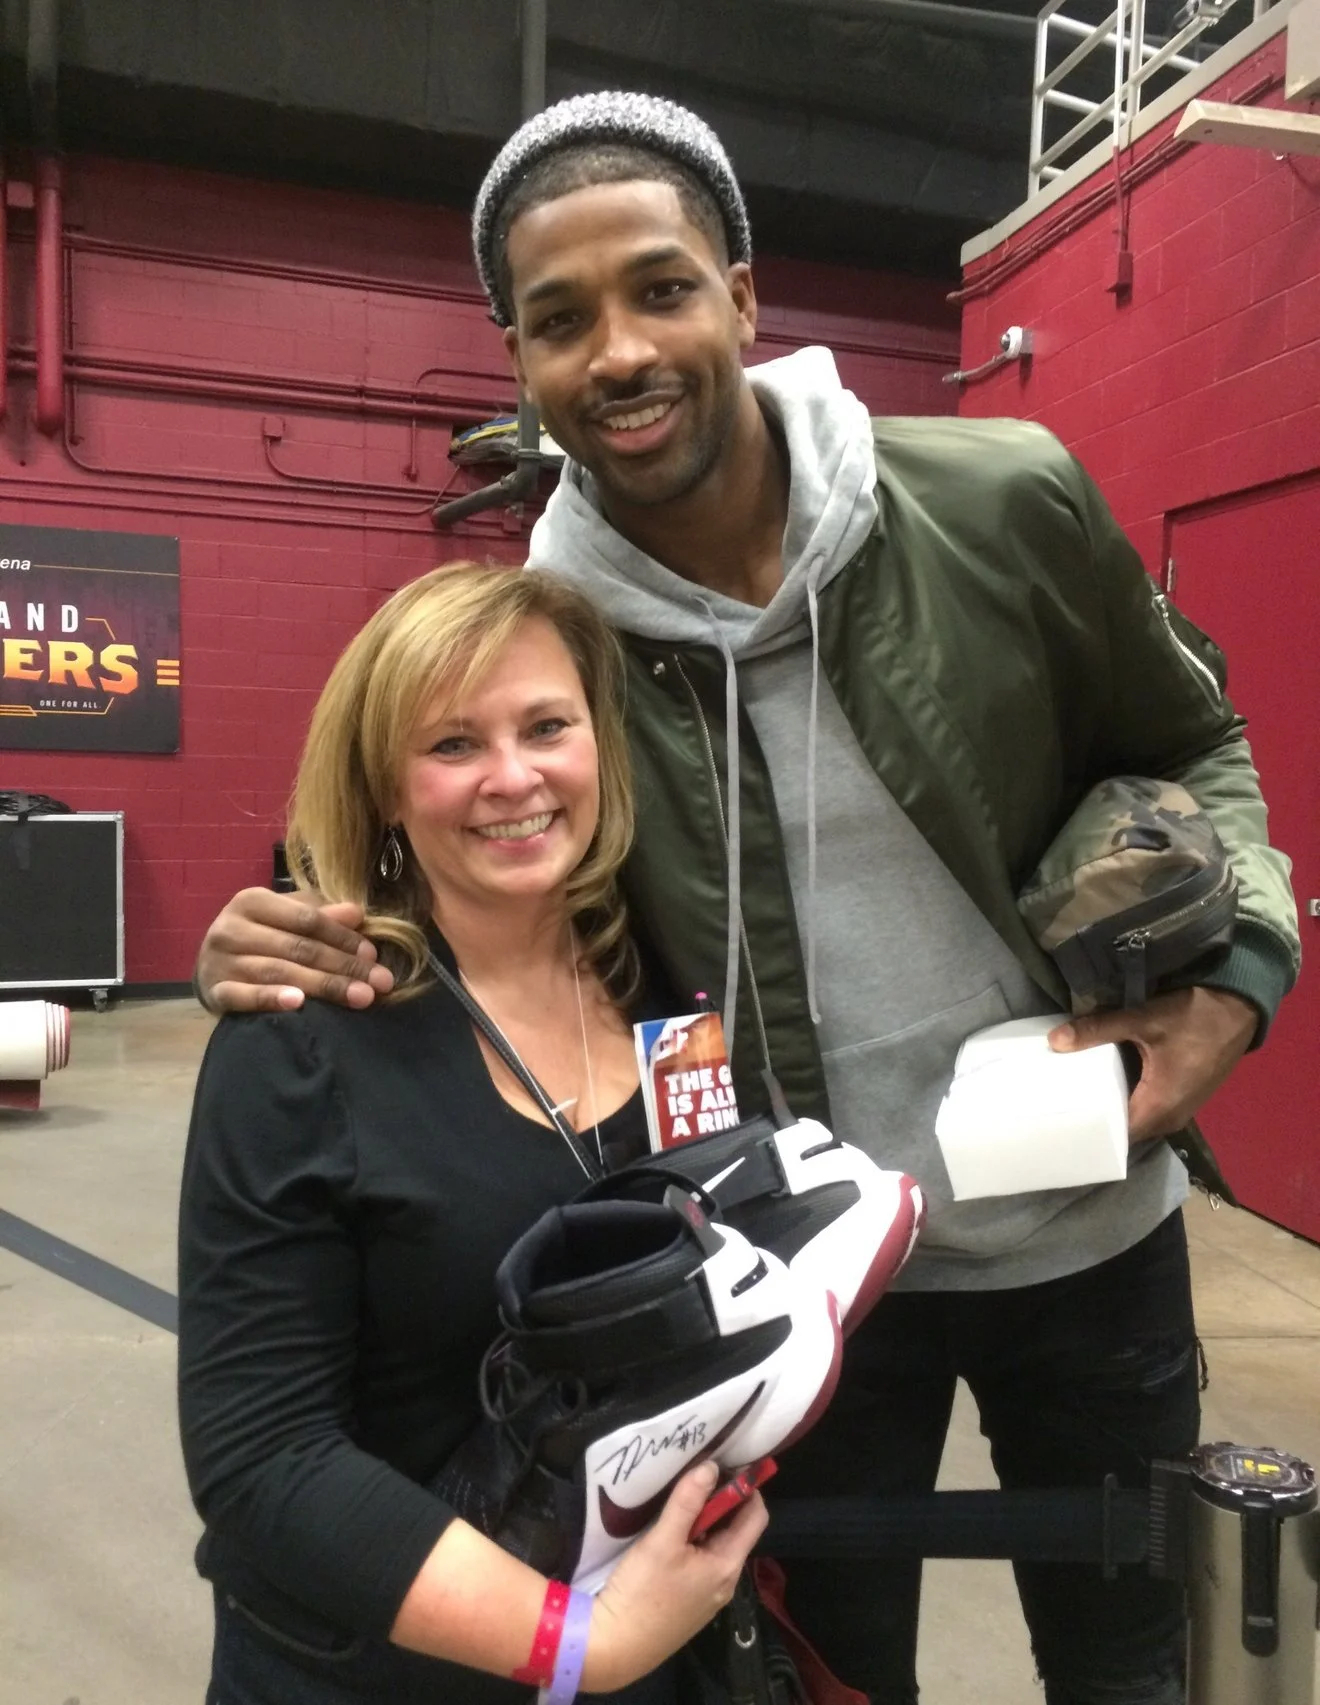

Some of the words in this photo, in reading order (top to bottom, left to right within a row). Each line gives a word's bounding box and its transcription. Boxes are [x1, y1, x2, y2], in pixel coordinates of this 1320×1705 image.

[3, 638, 139, 695] ERS
[62, 700, 78, 708] FOR
[664, 1067, 715, 1094] THE
[667, 1094, 694, 1117] IS
[671, 1116, 692, 1138] A
